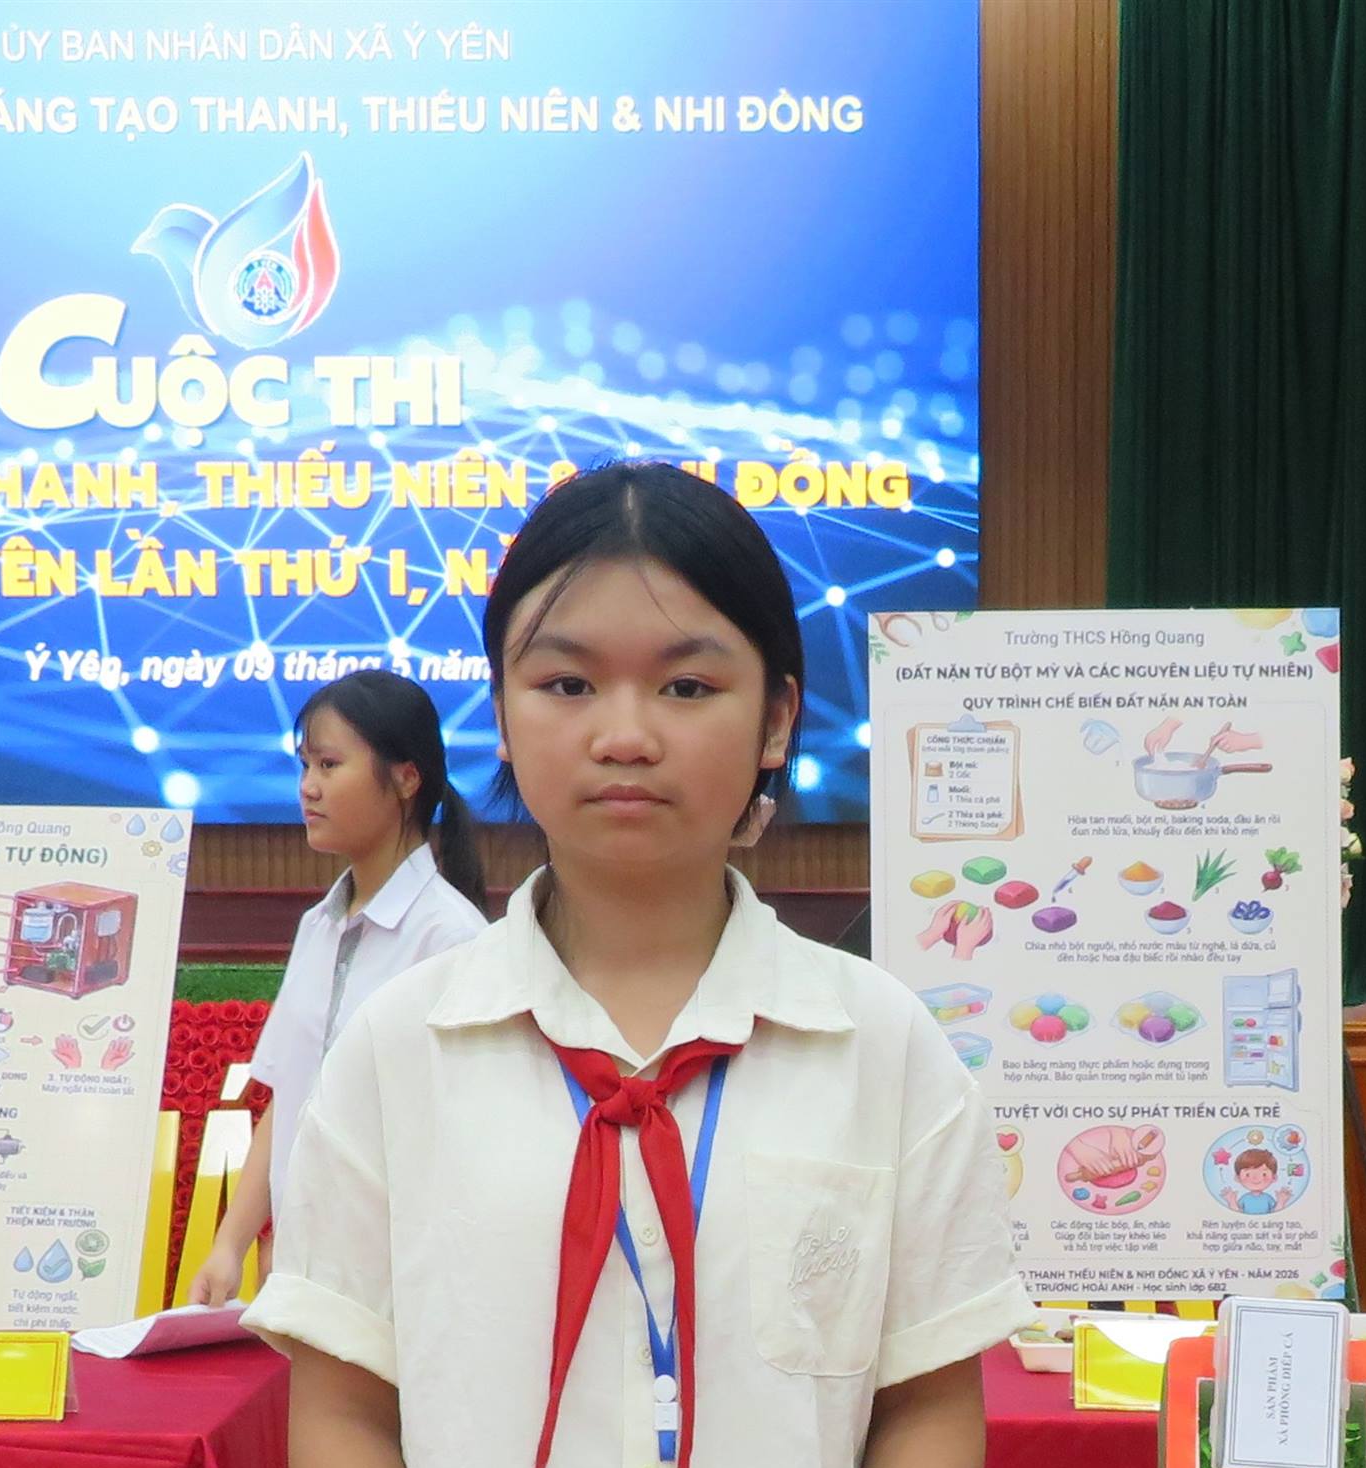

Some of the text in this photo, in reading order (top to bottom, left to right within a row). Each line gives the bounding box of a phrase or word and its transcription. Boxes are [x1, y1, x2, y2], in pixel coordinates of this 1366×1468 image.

[62, 30, 137, 61] BAN
[146, 23, 246, 61] NHÂN
[259, 23, 333, 61] DÂN
[345, 23, 392, 60] XÃ
[407, 22, 428, 60] Ý
[436, 22, 511, 60] YÊN
[90, 96, 178, 141] TẠO
[190, 96, 348, 138] THANH,
[363, 88, 486, 132] THIẾU
[501, 88, 598, 132] NIÊN
[613, 95, 641, 133] &
[655, 95, 725, 131] NHI
[738, 88, 863, 133] ĐỒNG
[314, 356, 464, 426] THI
[196, 440, 370, 510] THIẾU
[391, 451, 526, 508] NIÊN
[735, 440, 910, 508] ĐỒNG
[93, 529, 216, 596] LẦN
[236, 525, 370, 596] THỨ
[389, 551, 428, 604] I,
[1005, 629, 1204, 647] Trường THCS Hồng Quang
[26, 643, 274, 686] Ý Yên, ngày 09
[896, 663, 933, 682] (ĐẤT
[937, 664, 972, 683] NẶN
[974, 663, 997, 680] TỪ
[1064, 662, 1086, 679] VÀ
[1089, 661, 1121, 679] CÁC
[1125, 662, 1190, 679] NGUYÊN
[1194, 662, 1230, 682] LIỆU
[1232, 663, 1255, 681] TỰ
[1259, 661, 1313, 681] NHIÊN)
[7, 845, 36, 865] TỰ
[40, 845, 108, 867] ĐỘNG)
[994, 1101, 1280, 1123] TUYỆT VỜI CHO SỰ PHÁT TRIỂN CỦA TRẺ
